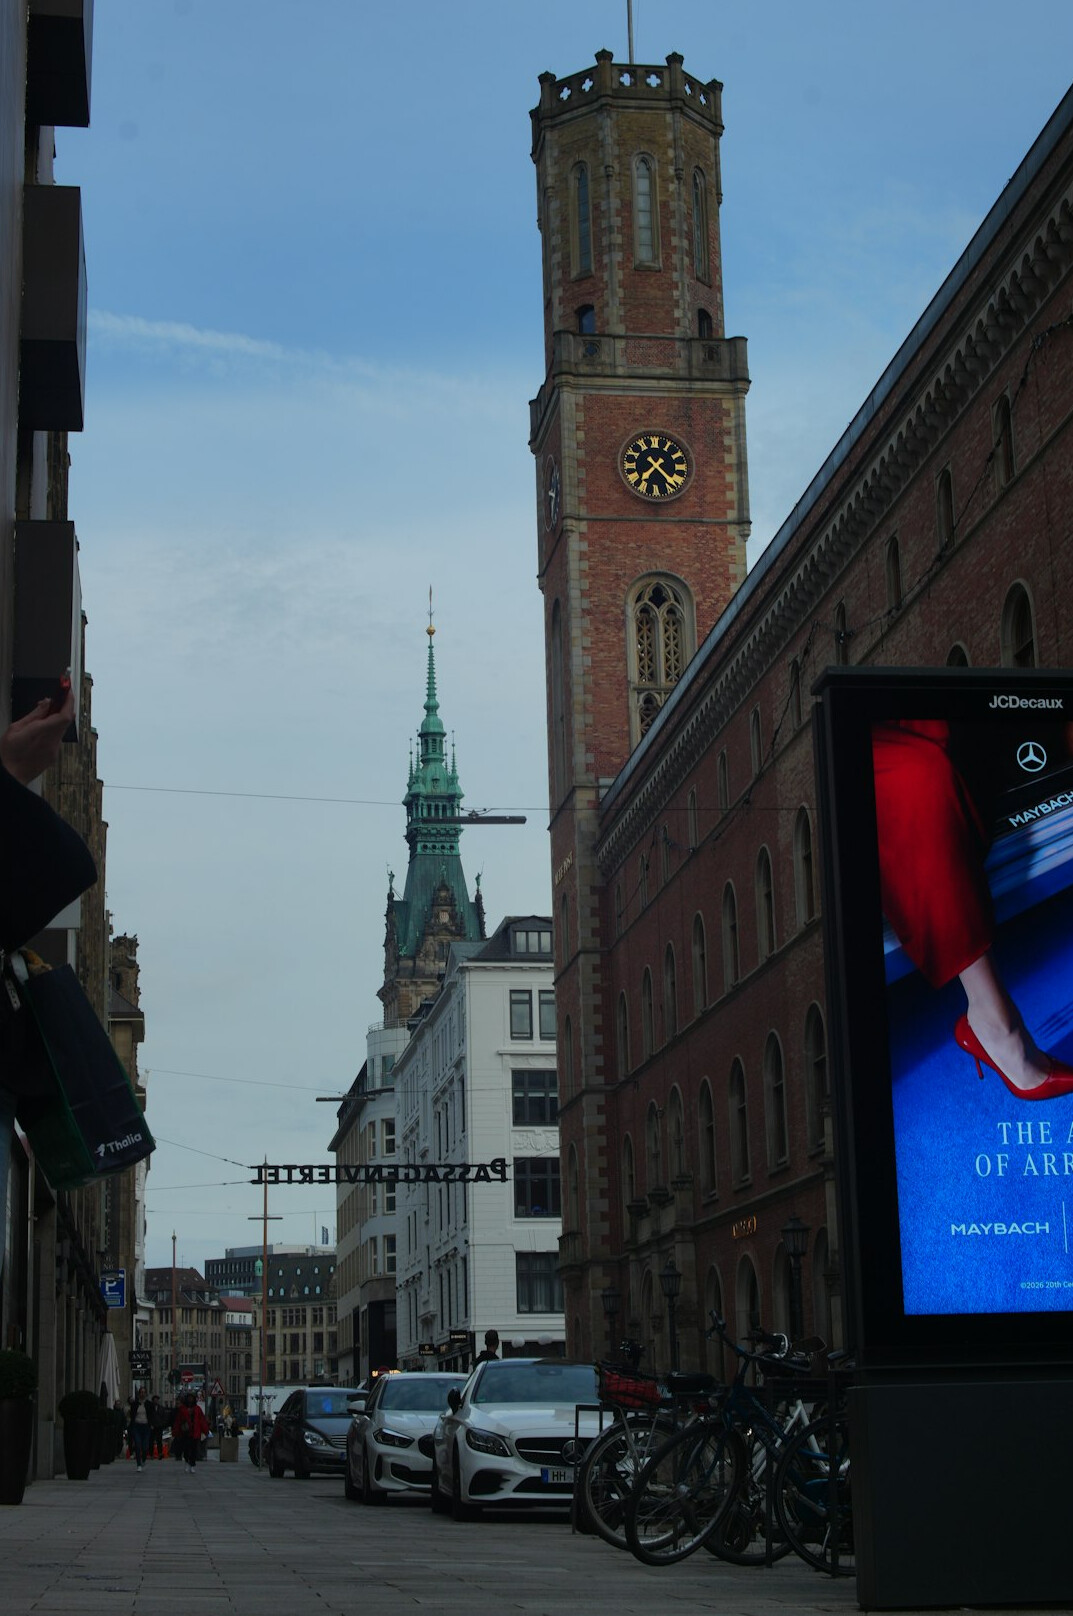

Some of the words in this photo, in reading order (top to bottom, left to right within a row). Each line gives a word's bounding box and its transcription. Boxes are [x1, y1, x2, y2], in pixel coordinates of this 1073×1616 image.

[989, 695, 1064, 709] JCDecaux
[1008, 790, 1073, 828] MAYBACH
[106, 1132, 143, 1153] Thalia
[997, 1121, 1052, 1145] THE
[975, 1153, 1010, 1177] OF
[951, 1222, 1050, 1236] MAYBACH
[1045, 1281, 1062, 1289] 20th
